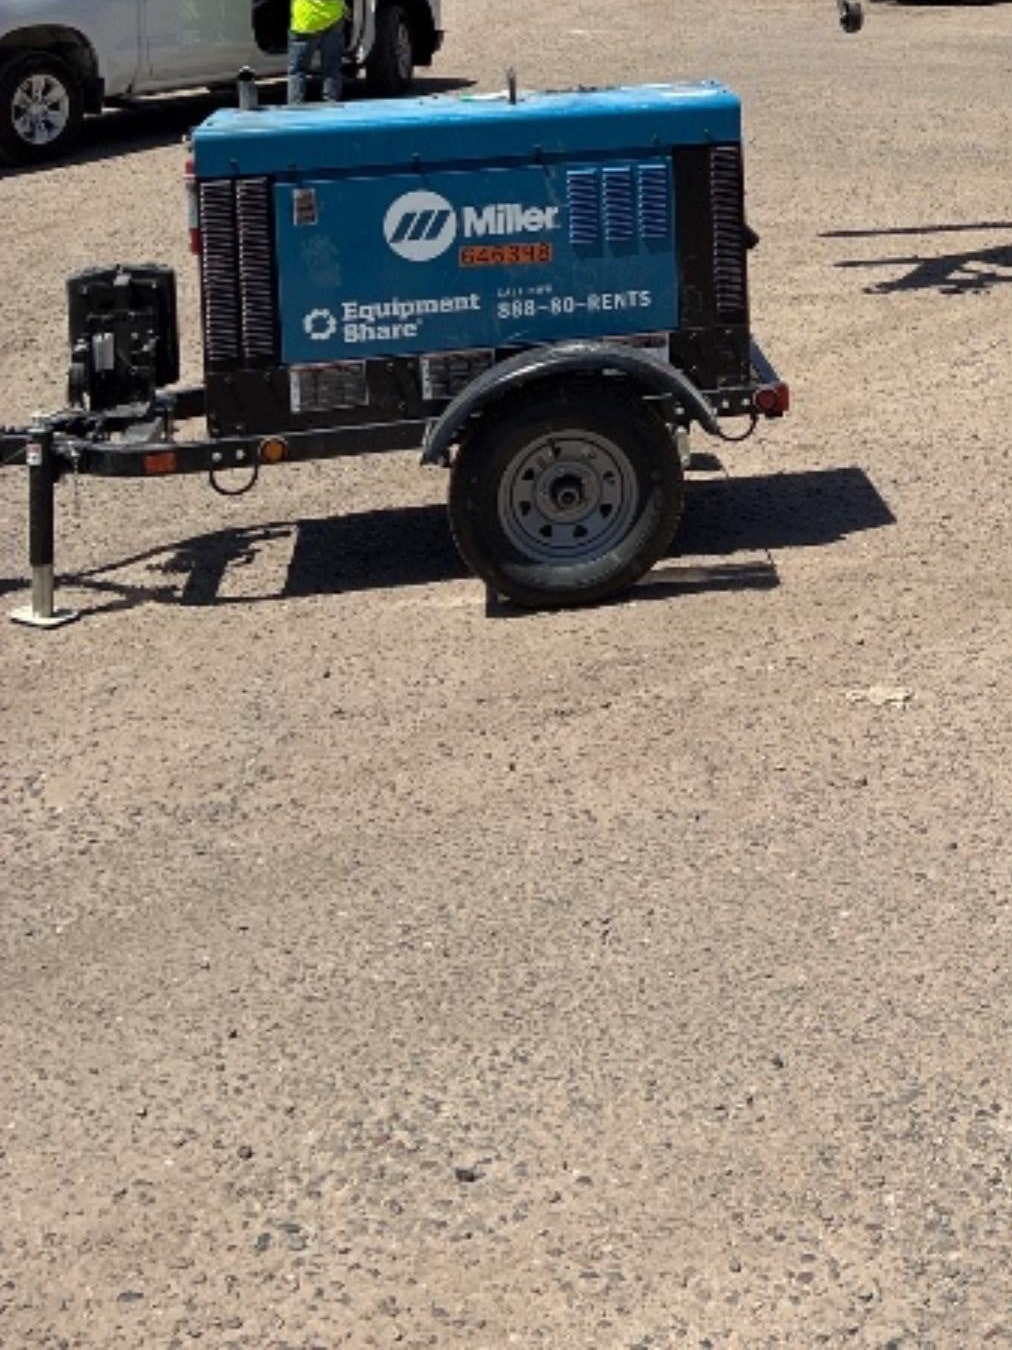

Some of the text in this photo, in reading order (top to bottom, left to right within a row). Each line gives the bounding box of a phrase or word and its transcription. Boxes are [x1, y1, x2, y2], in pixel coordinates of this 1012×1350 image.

[462, 203, 559, 238] Miller
[341, 293, 481, 323] Equipment
[496, 290, 653, 320] 888-80-RENTS
[344, 322, 418, 343] Share
